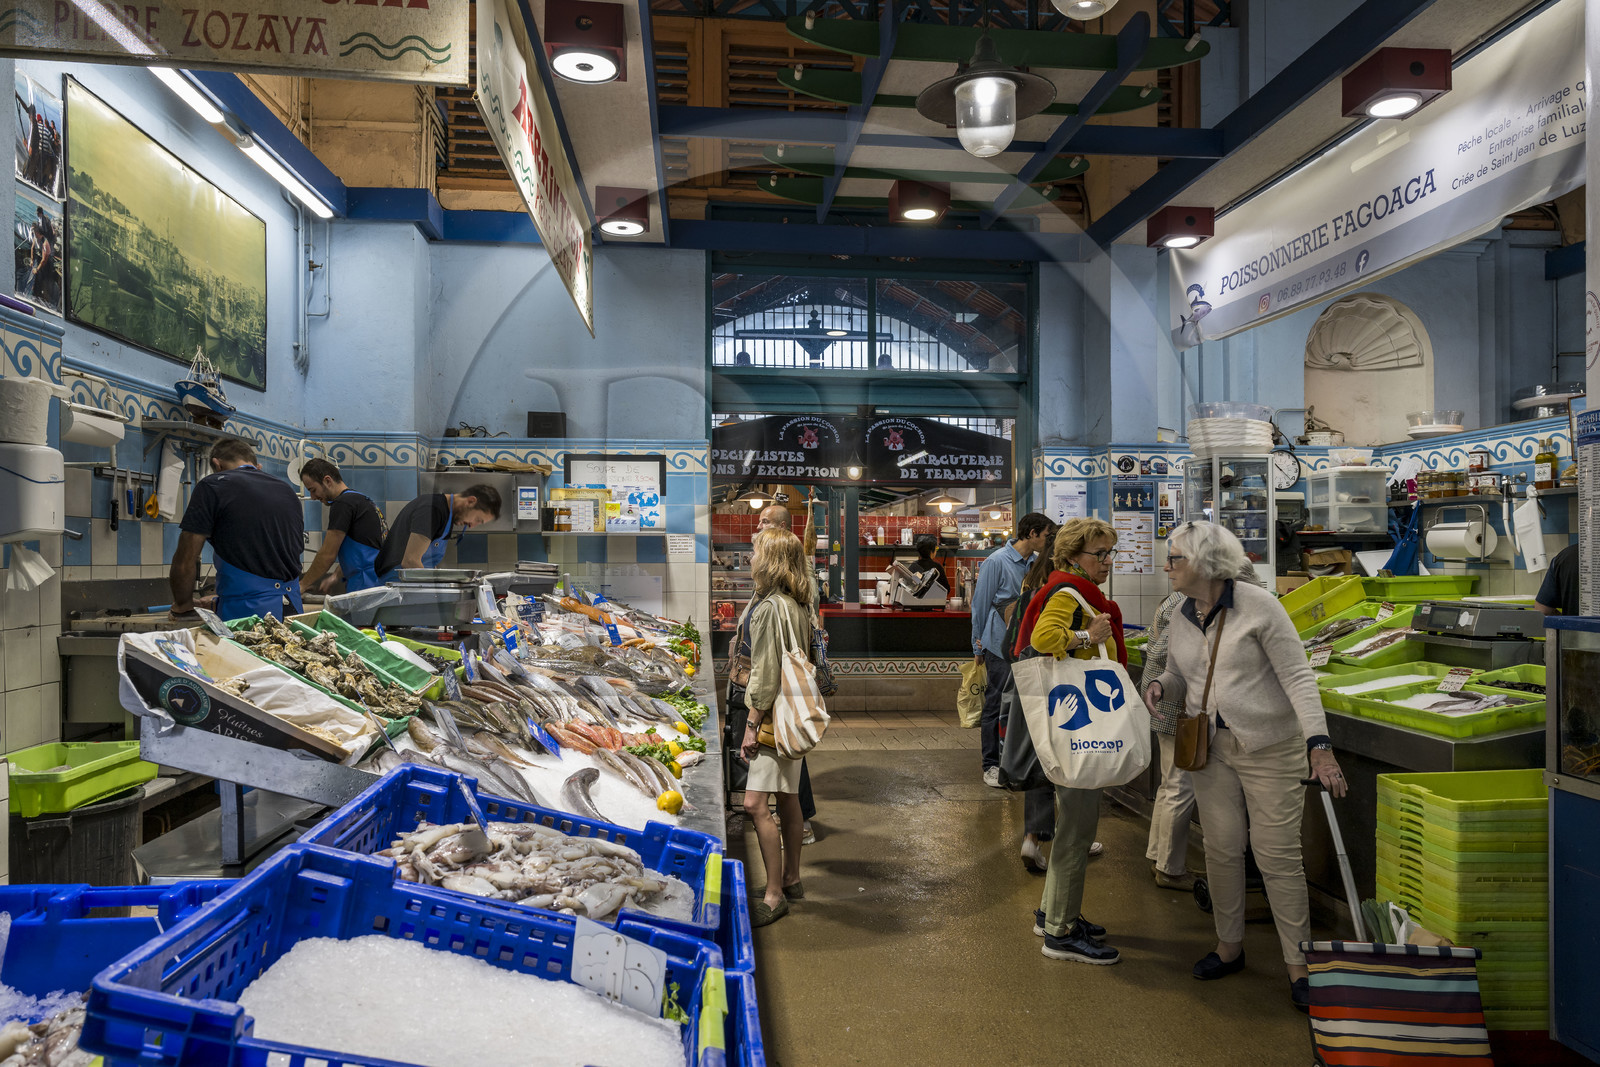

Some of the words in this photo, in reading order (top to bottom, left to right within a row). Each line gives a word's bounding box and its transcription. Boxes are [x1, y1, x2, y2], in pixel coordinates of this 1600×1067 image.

[182, 9, 330, 56] ZOZAYA
[1457, 133, 1482, 155] Pêche
[1485, 118, 1511, 140] locale
[1526, 85, 1571, 117] Arrivage
[1489, 124, 1534, 155] Entreprise
[1537, 97, 1586, 129] familial
[1452, 172, 1474, 190] Criée
[1476, 164, 1488, 178] de
[1491, 152, 1513, 171] Saint
[1514, 141, 1535, 163] Jean
[1538, 132, 1557, 147] de
[1562, 122, 1586, 138] Luz
[1219, 223, 1329, 296] POISSONNERIE
[1332, 168, 1437, 242] FAGOAGA
[1276, 262, 1347, 303] 06.89.77.93.48
[782, 416, 811, 432] PASSION
[821, 419, 840, 444] COCHON
[867, 418, 895, 434] PASSION
[906, 421, 926, 445] COCHON
[586, 463, 616, 474] SOUPE
[625, 464, 640, 474] DE
[900, 468, 919, 479] DE
[218, 708, 264, 739] Huîtres
[1070, 738, 1123, 752] biocoop
